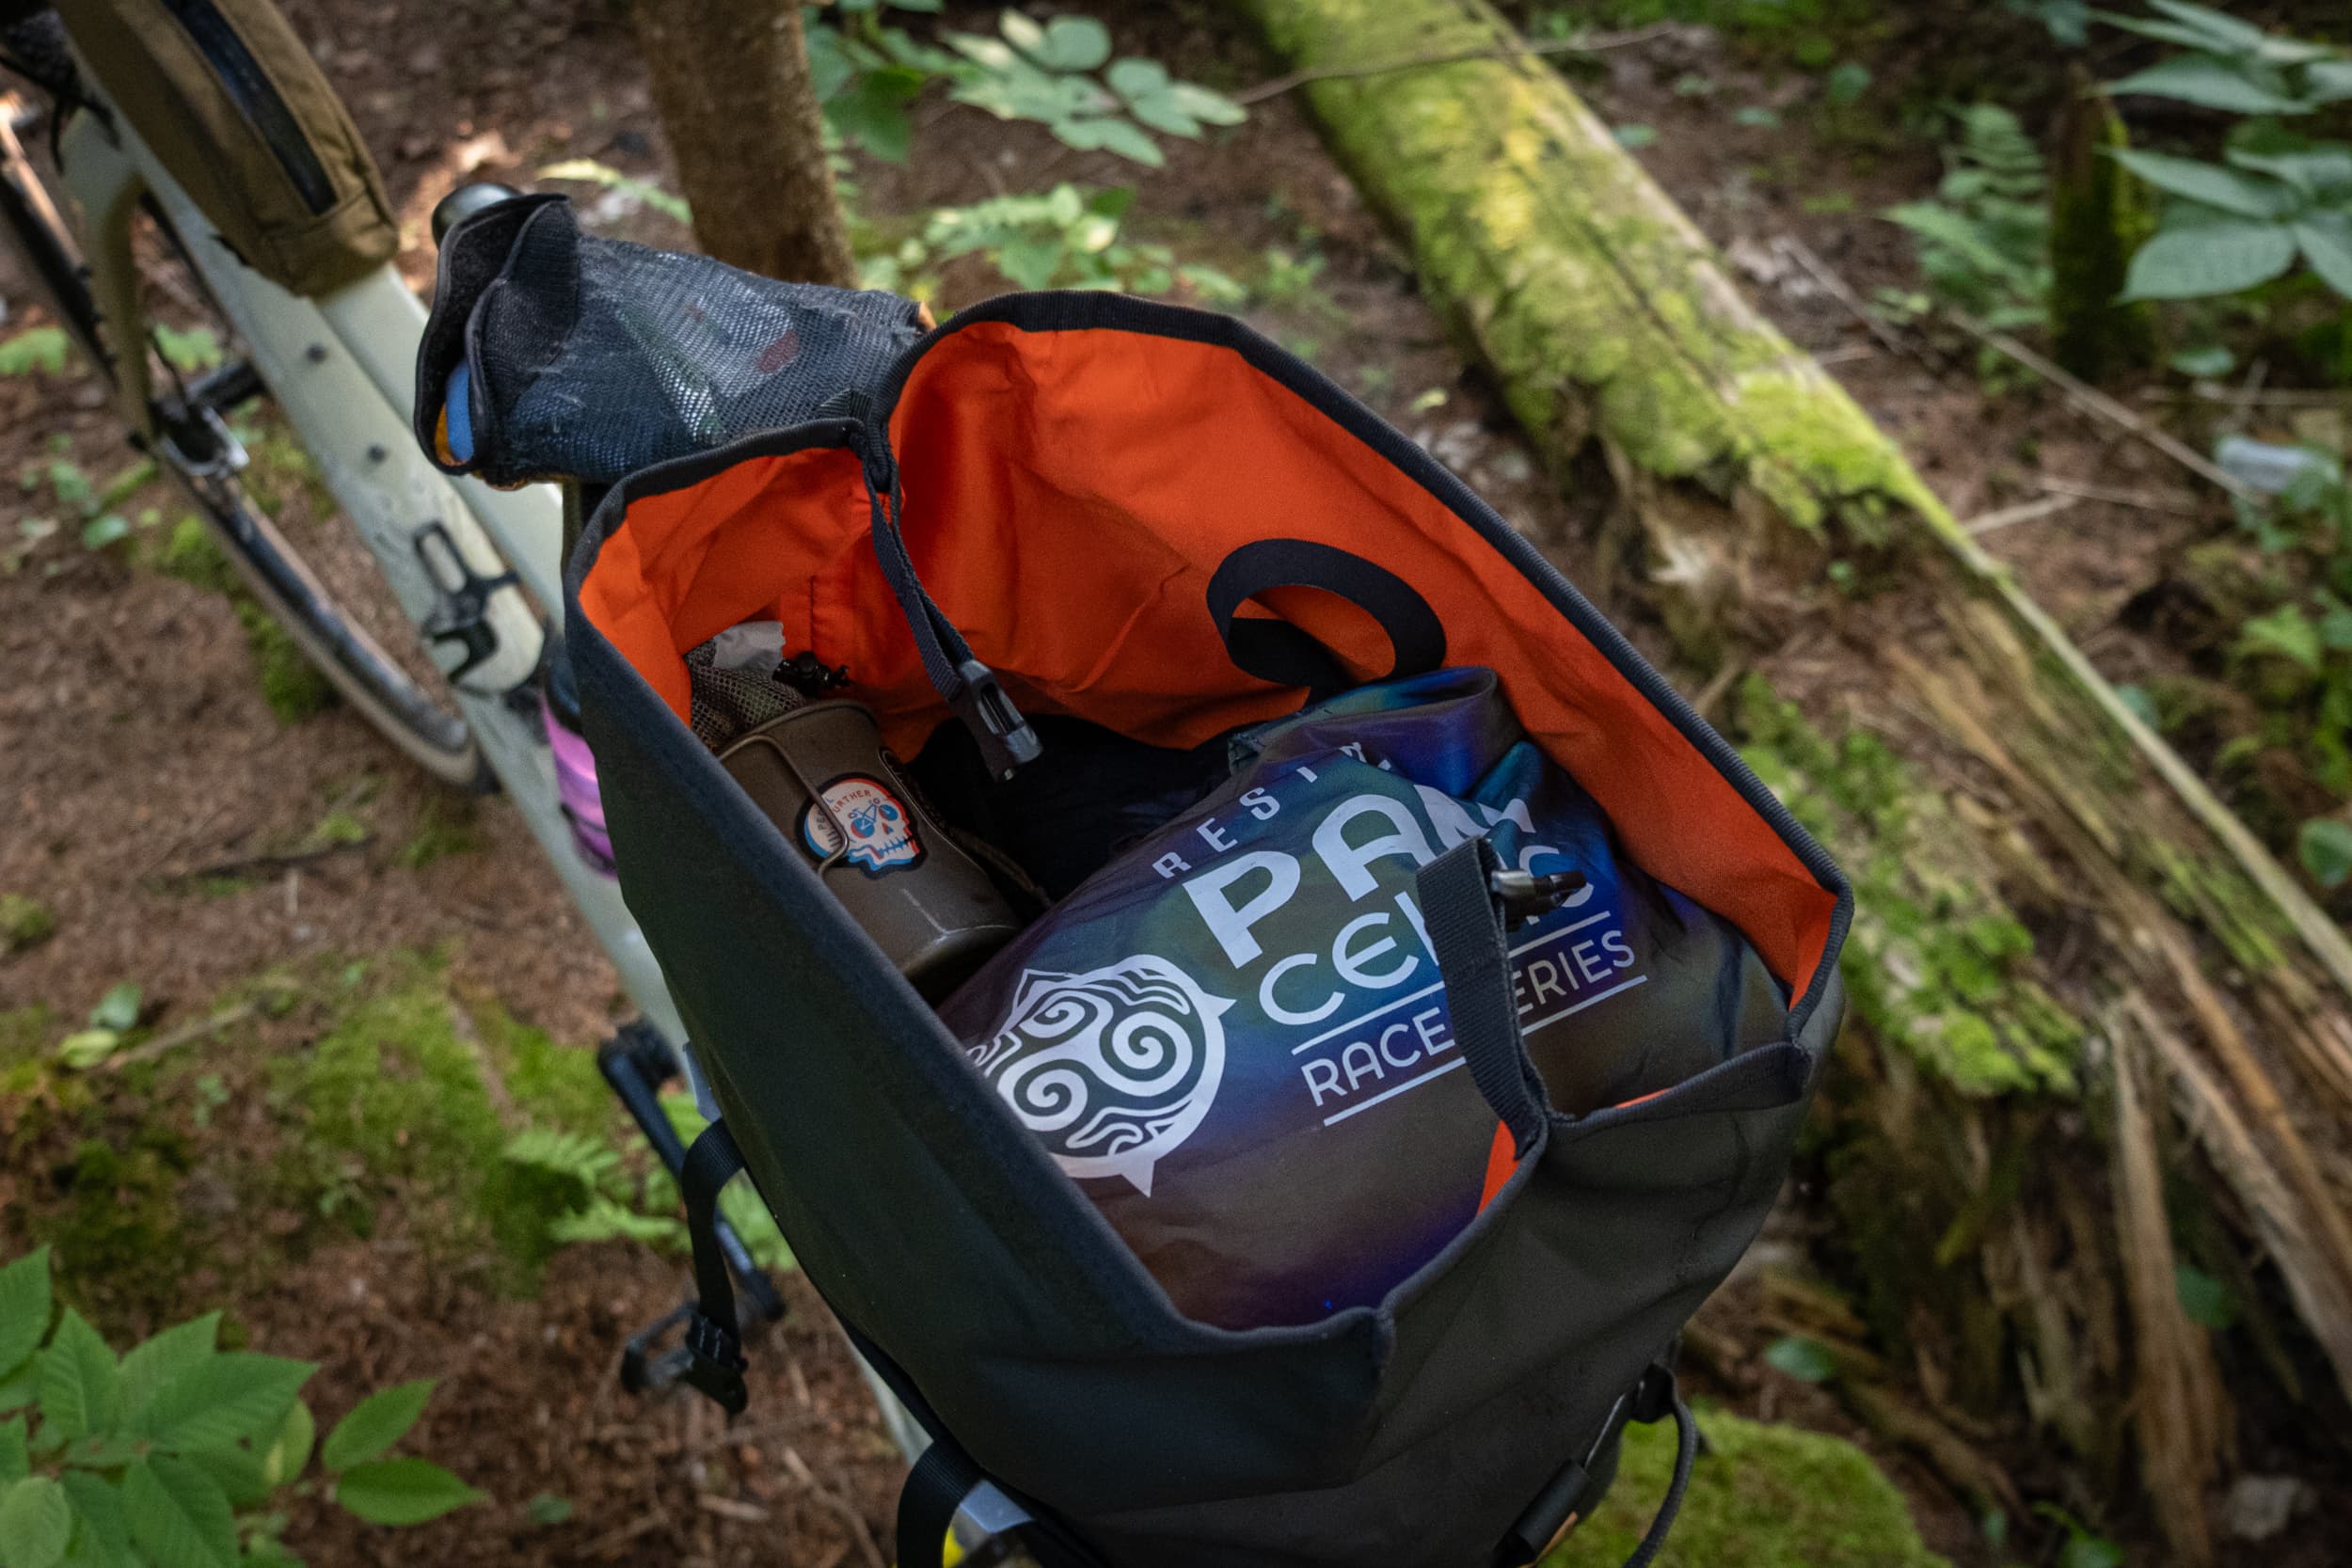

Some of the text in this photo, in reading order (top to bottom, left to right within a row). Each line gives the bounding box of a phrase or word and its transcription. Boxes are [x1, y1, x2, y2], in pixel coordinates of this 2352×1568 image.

[834, 790, 871, 813] URTHER
[1301, 929, 1635, 1107] RACE ERIES
